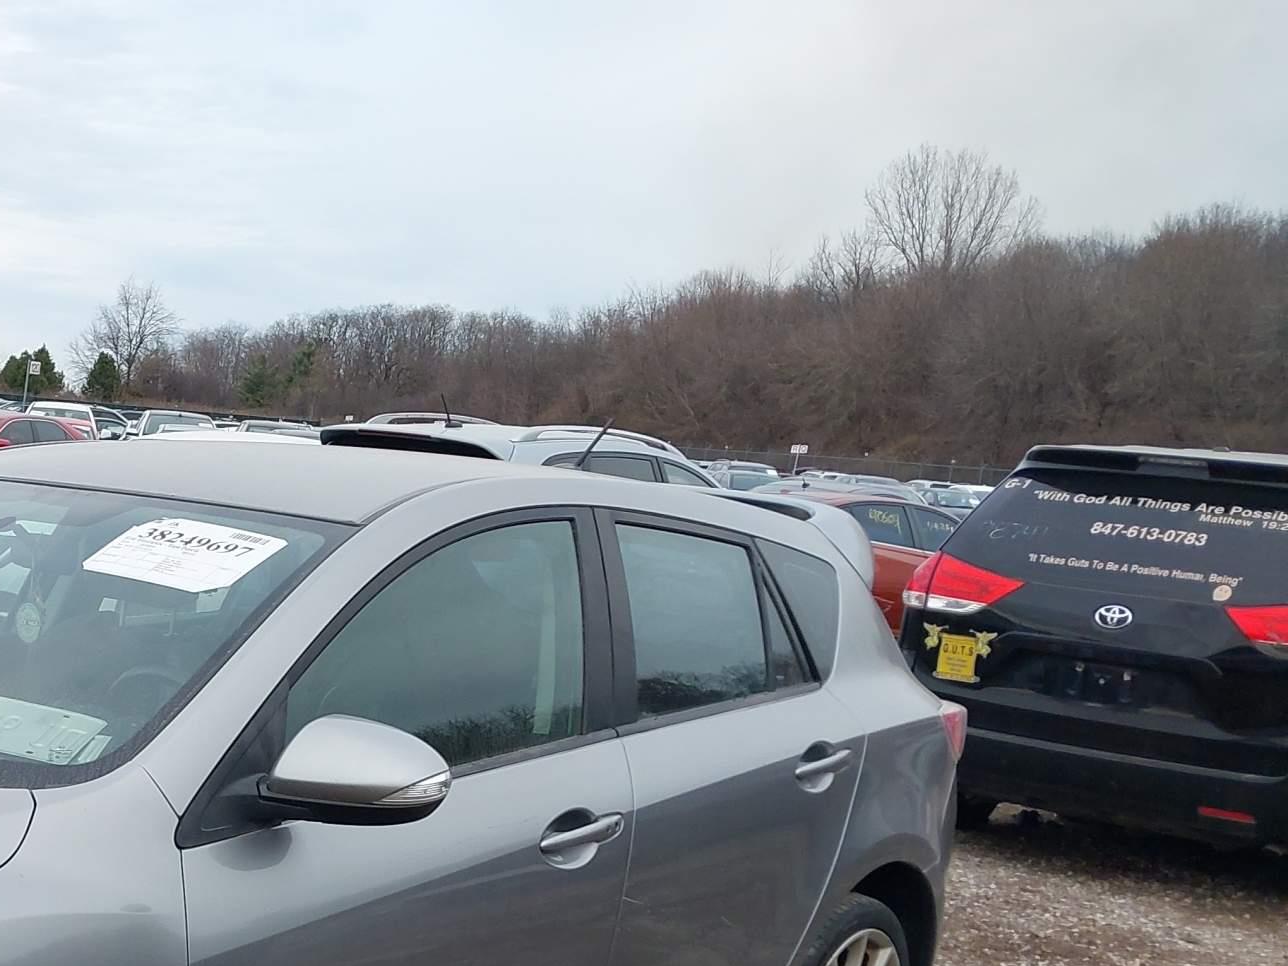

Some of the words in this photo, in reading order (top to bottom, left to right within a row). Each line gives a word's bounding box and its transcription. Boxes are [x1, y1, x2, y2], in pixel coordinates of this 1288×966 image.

[1004, 478, 1032, 489] G-1
[1073, 492, 1108, 504] God
[1109, 496, 1134, 507] All
[1136, 497, 1192, 513] Things
[1194, 502, 1226, 515] Are
[1198, 513, 1253, 527] Matthew
[137, 527, 255, 557] 38249697
[1090, 520, 1209, 546] 847-613-0783
[1039, 553, 1066, 566] Takes
[1067, 557, 1090, 568] Guts
[1092, 559, 1104, 570] To
[1105, 561, 1119, 571] Be
[1120, 563, 1128, 573] A
[1130, 564, 1169, 577] Positive
